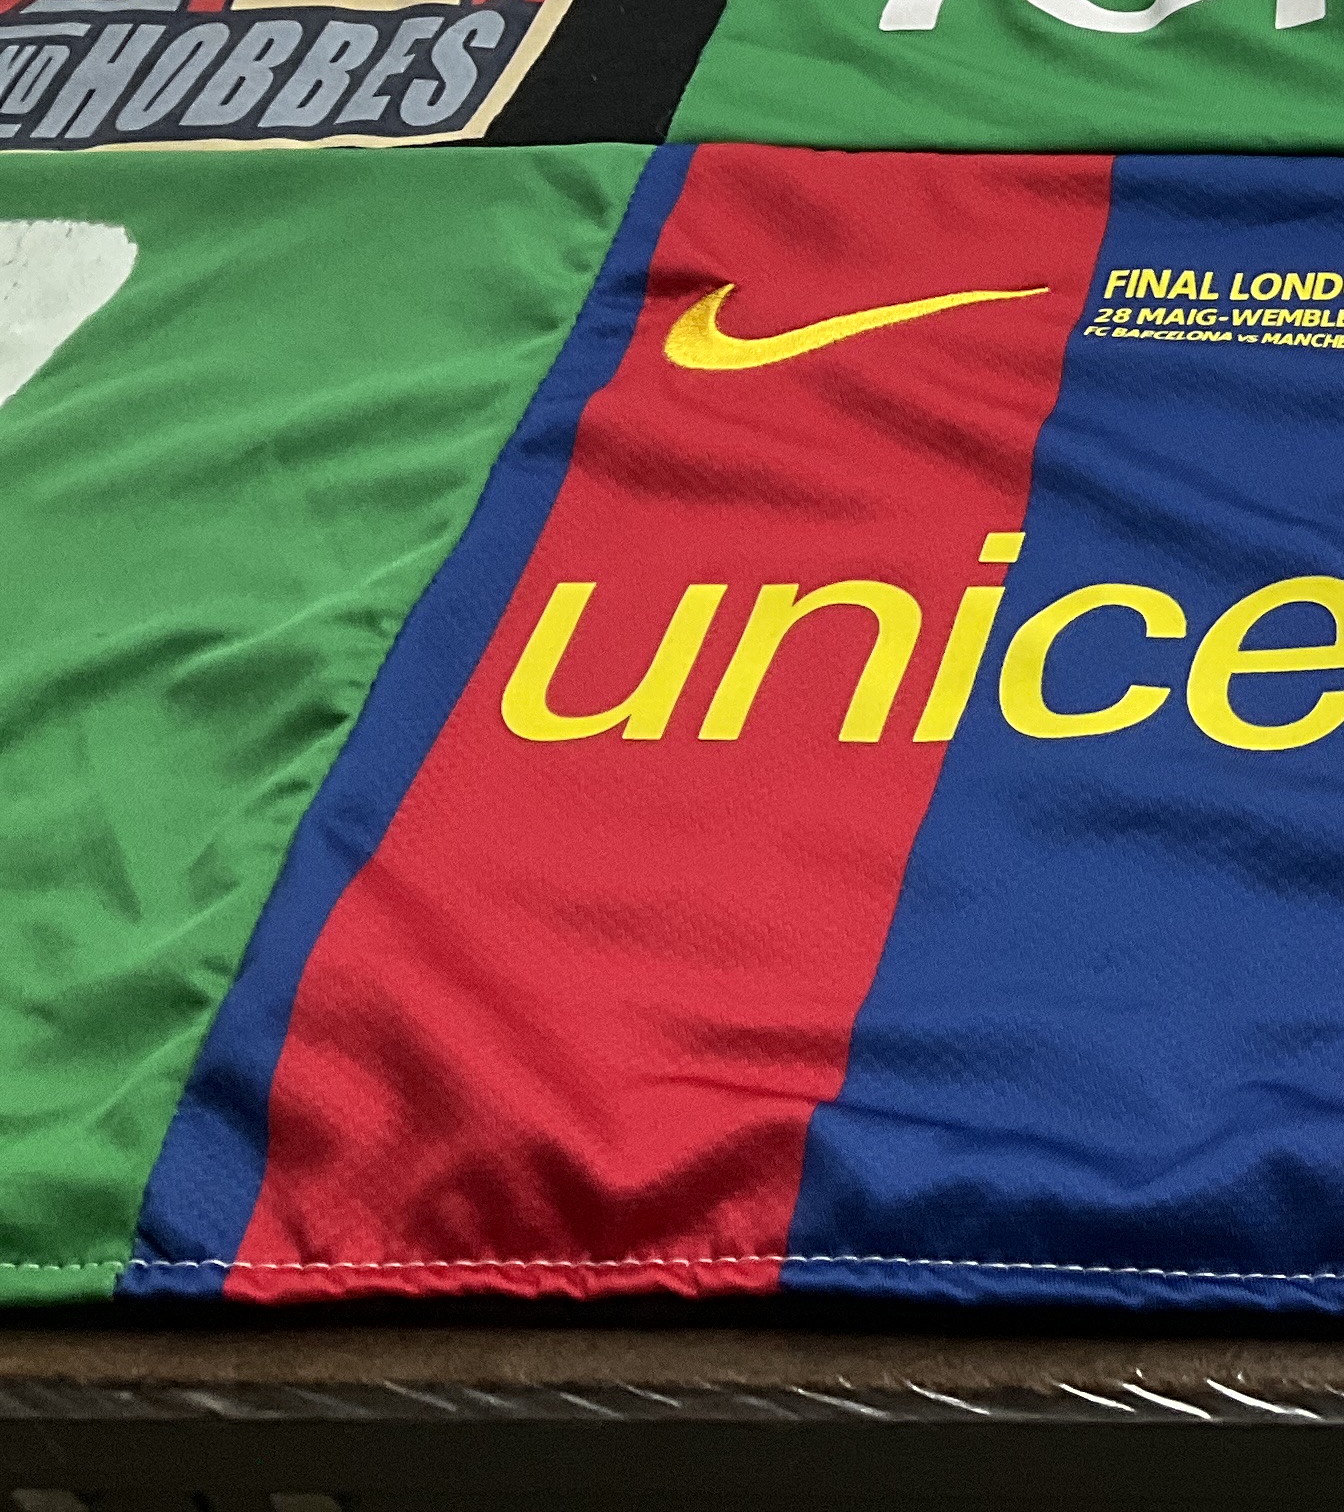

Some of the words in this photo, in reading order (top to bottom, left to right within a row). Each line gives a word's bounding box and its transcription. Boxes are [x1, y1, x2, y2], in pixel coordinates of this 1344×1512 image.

[29, 9, 506, 140] HOBBES
[1103, 268, 1219, 301] FINAL
[1093, 307, 1131, 325] 28
[1083, 325, 1108, 338] FC
[1111, 327, 1233, 342] BARCELONA
